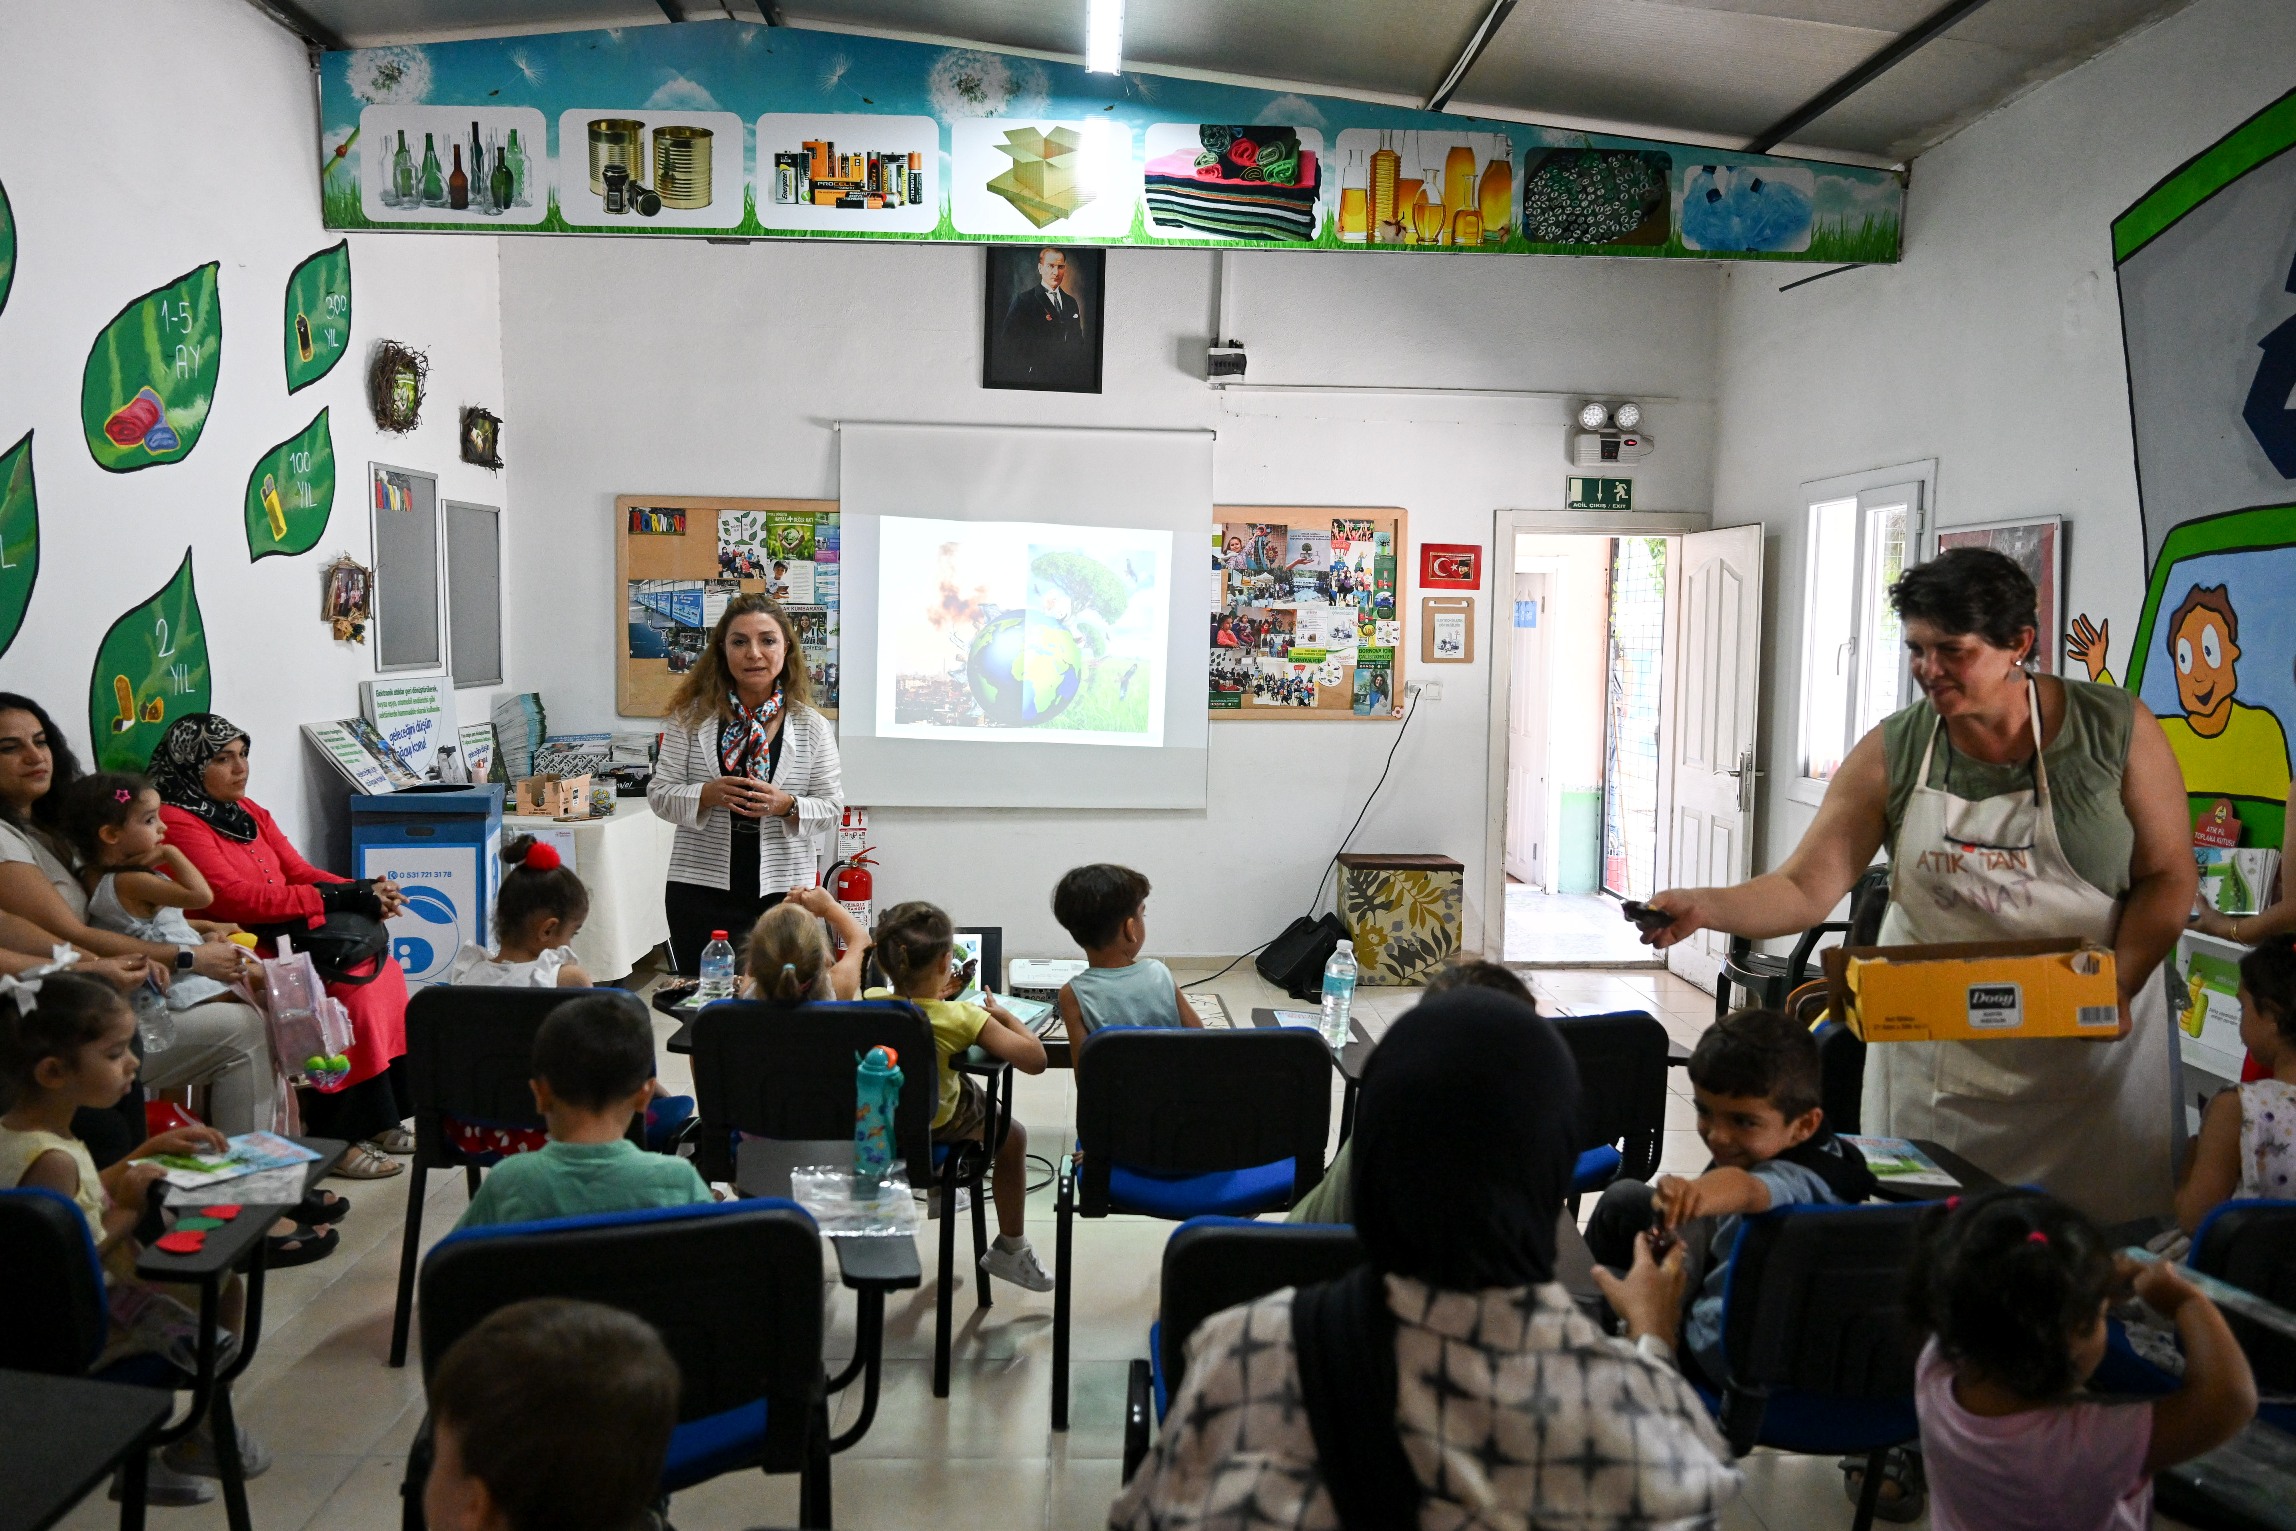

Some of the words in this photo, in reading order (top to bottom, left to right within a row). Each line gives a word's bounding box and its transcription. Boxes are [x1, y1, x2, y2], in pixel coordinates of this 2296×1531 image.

[780, 171, 788, 200] Energizer
[161, 299, 193, 334] 1-5
[325, 294, 347, 320] 300
[324, 327, 340, 350] YIL
[175, 344, 200, 380] AY
[289, 451, 311, 474] 100
[297, 480, 318, 509] YIL
[155, 618, 176, 658] 2
[170, 663, 196, 696] YIL
[415, 718, 433, 735] düşün
[406, 871, 419, 879] 531
